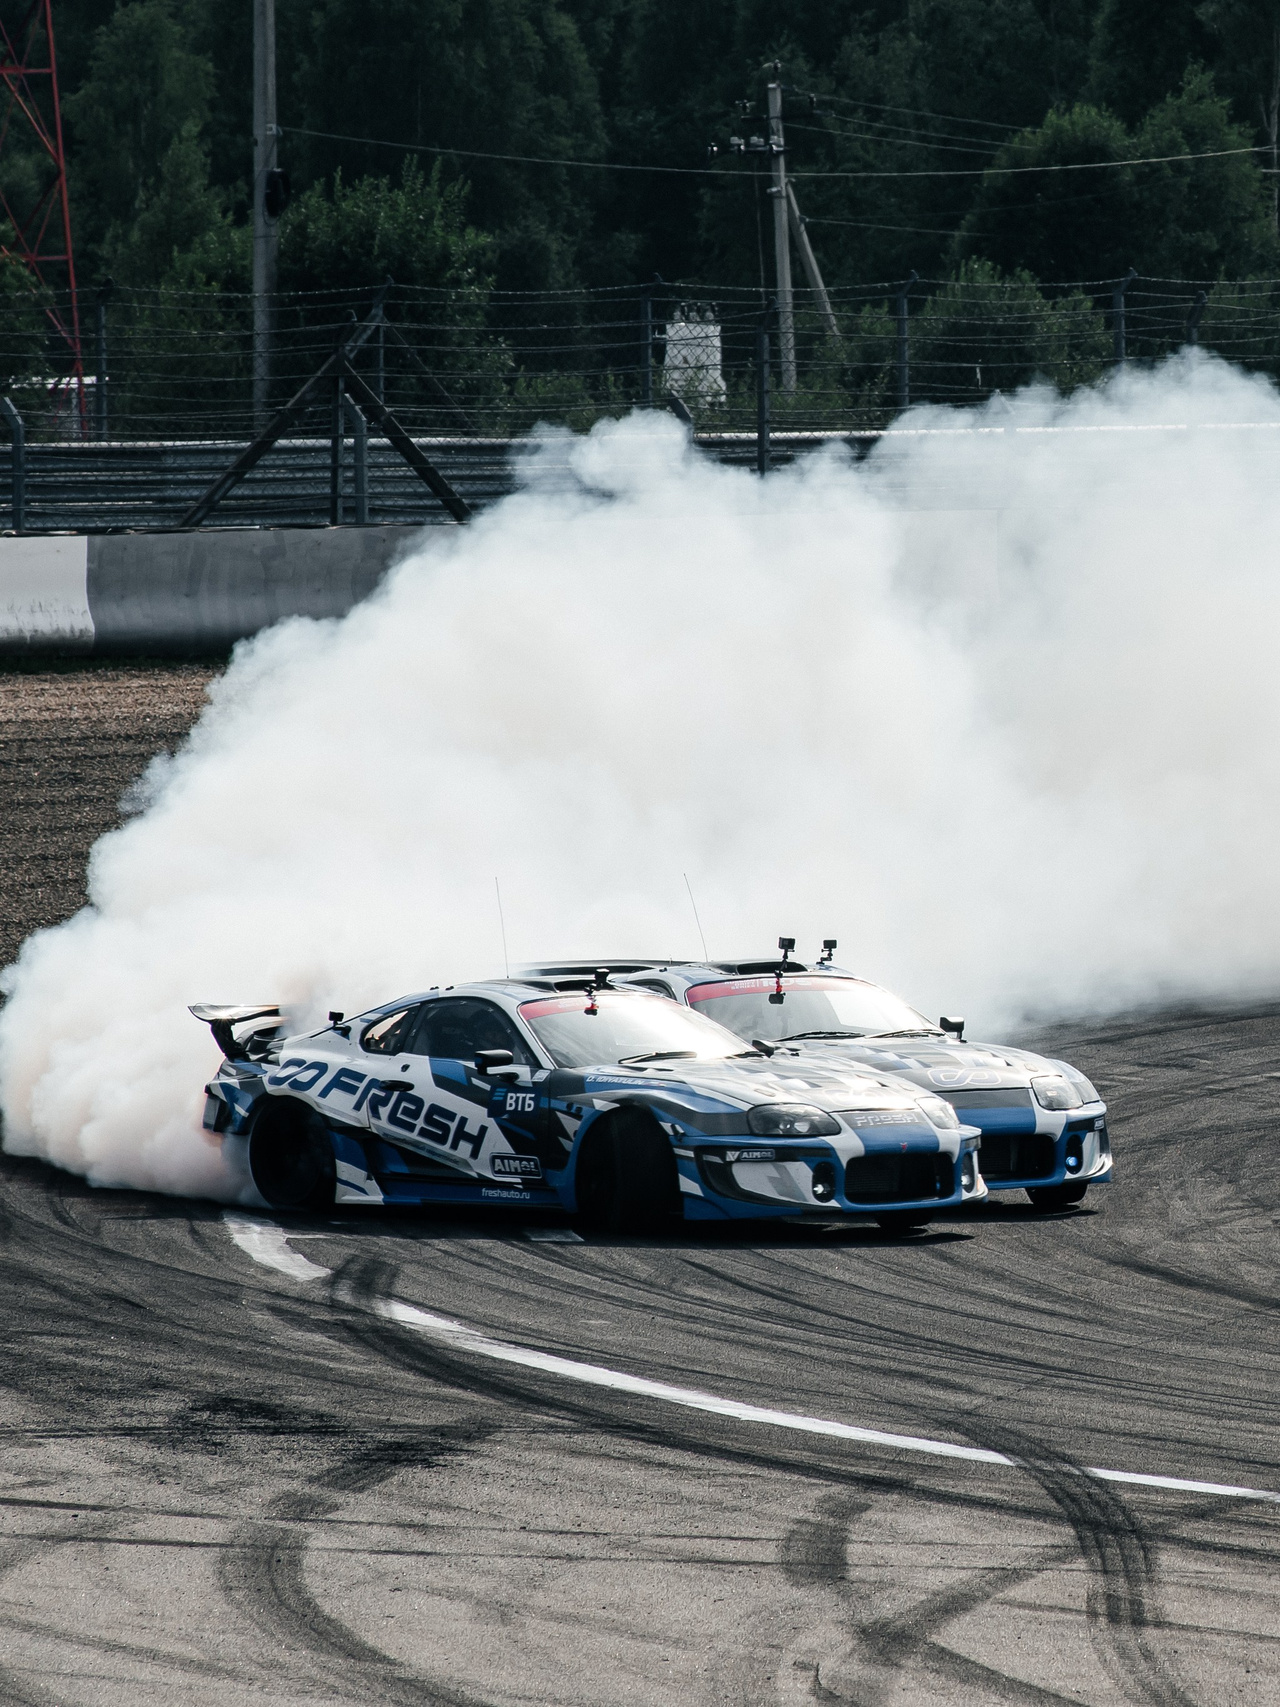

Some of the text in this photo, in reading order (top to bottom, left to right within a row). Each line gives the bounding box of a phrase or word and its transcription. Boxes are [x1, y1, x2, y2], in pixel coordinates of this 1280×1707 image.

[506, 1093, 535, 1111] ВТБ
[741, 1151, 773, 1159] AIMOL
[494, 1159, 539, 1172] AIMOL
[481, 1188, 531, 1199] freshauto.ru
